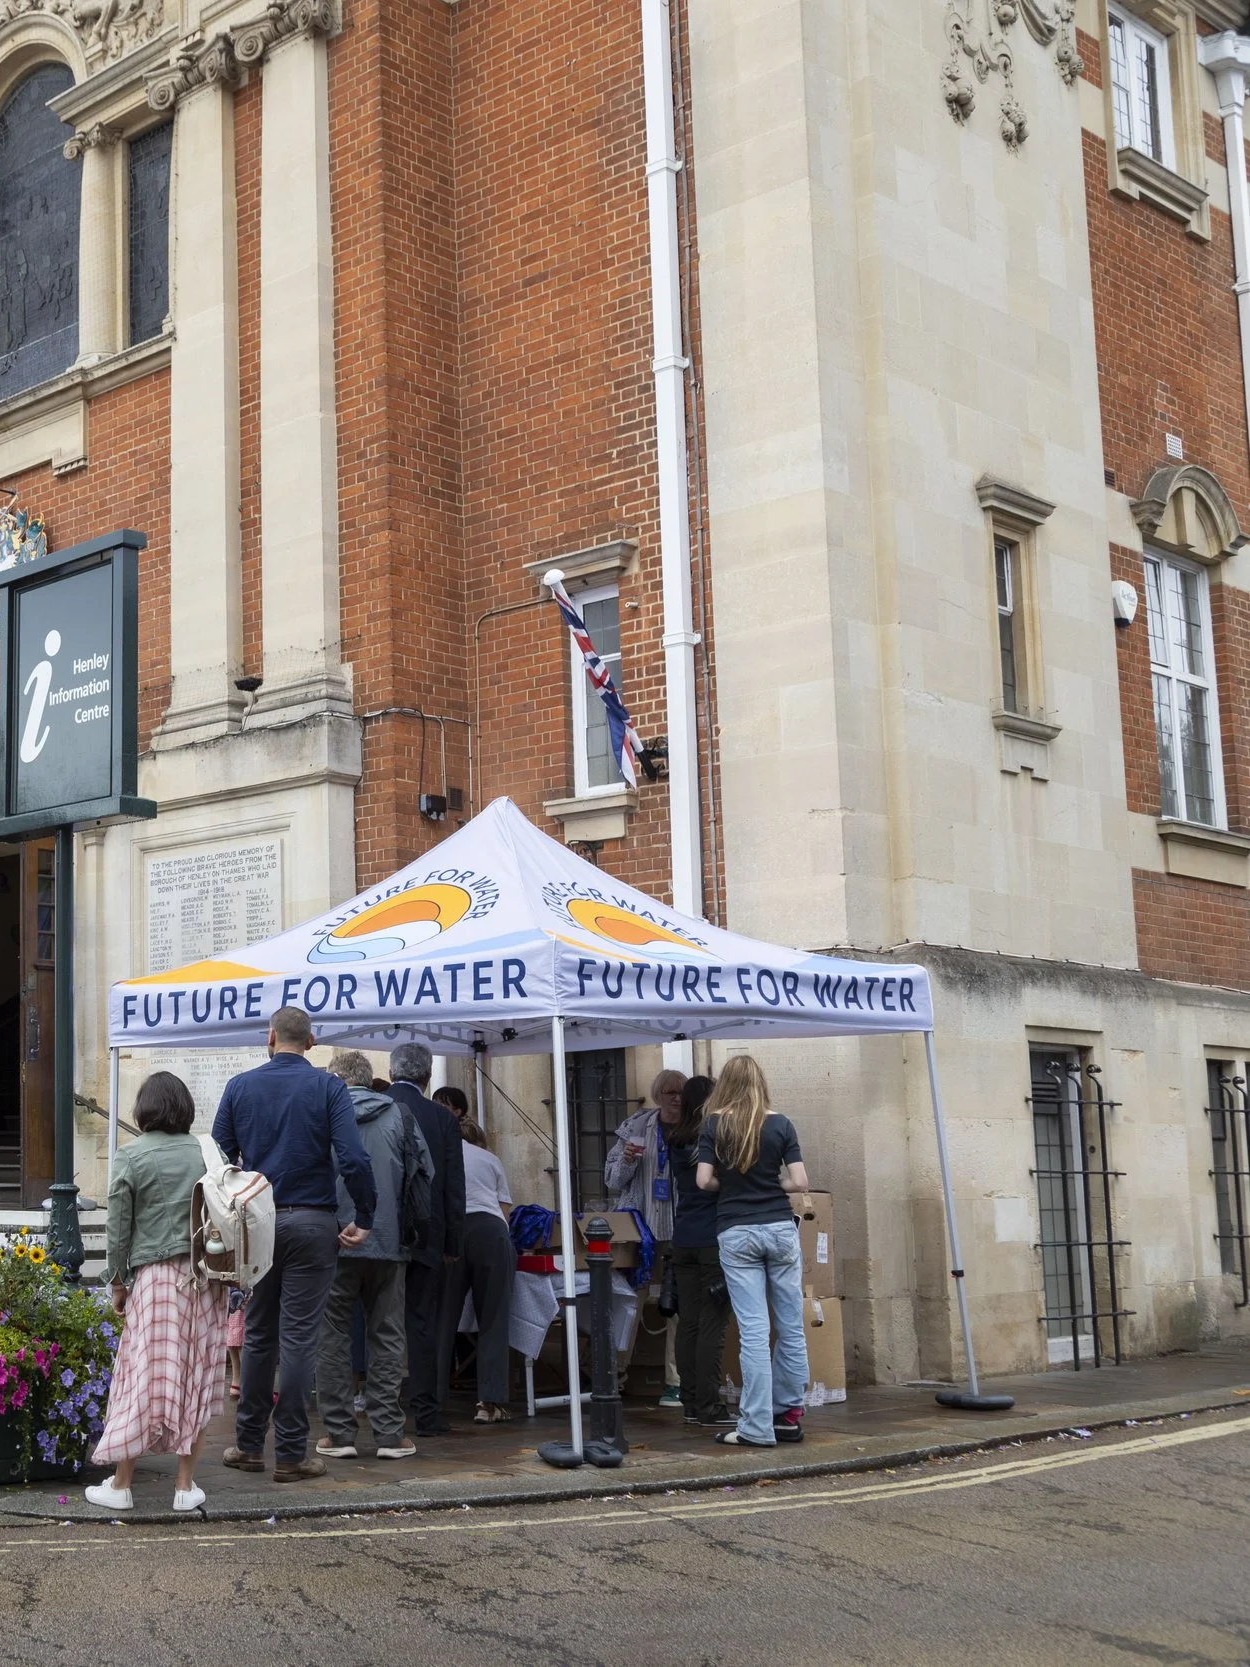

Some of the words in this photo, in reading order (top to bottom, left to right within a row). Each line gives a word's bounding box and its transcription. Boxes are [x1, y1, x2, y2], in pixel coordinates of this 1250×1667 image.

[73, 652, 109, 674] Henley
[50, 678, 110, 706] Information
[74, 704, 110, 724] Centre
[174, 858, 192, 867] PROUD
[238, 847, 264, 856] MEMORY
[219, 859, 243, 868] HEROES
[151, 878, 177, 886] BOROUGH
[188, 872, 210, 880] HENLEY
[222, 866, 245, 875] THAMES
[234, 874, 254, 882] GREAT
[313, 877, 418, 936] FUTURE
[424, 869, 474, 883] FOR
[464, 876, 500, 921] WATER
[542, 882, 585, 930] FUTURE
[565, 882, 608, 902] FOR
[611, 896, 708, 946] WATER
[123, 982, 263, 1029] FUTURE
[280, 974, 358, 1012] FOR
[374, 959, 528, 1007] WATER
[578, 958, 727, 1004] FUTURE
[737, 968, 805, 1006] FOR
[813, 974, 916, 1013] WATER
